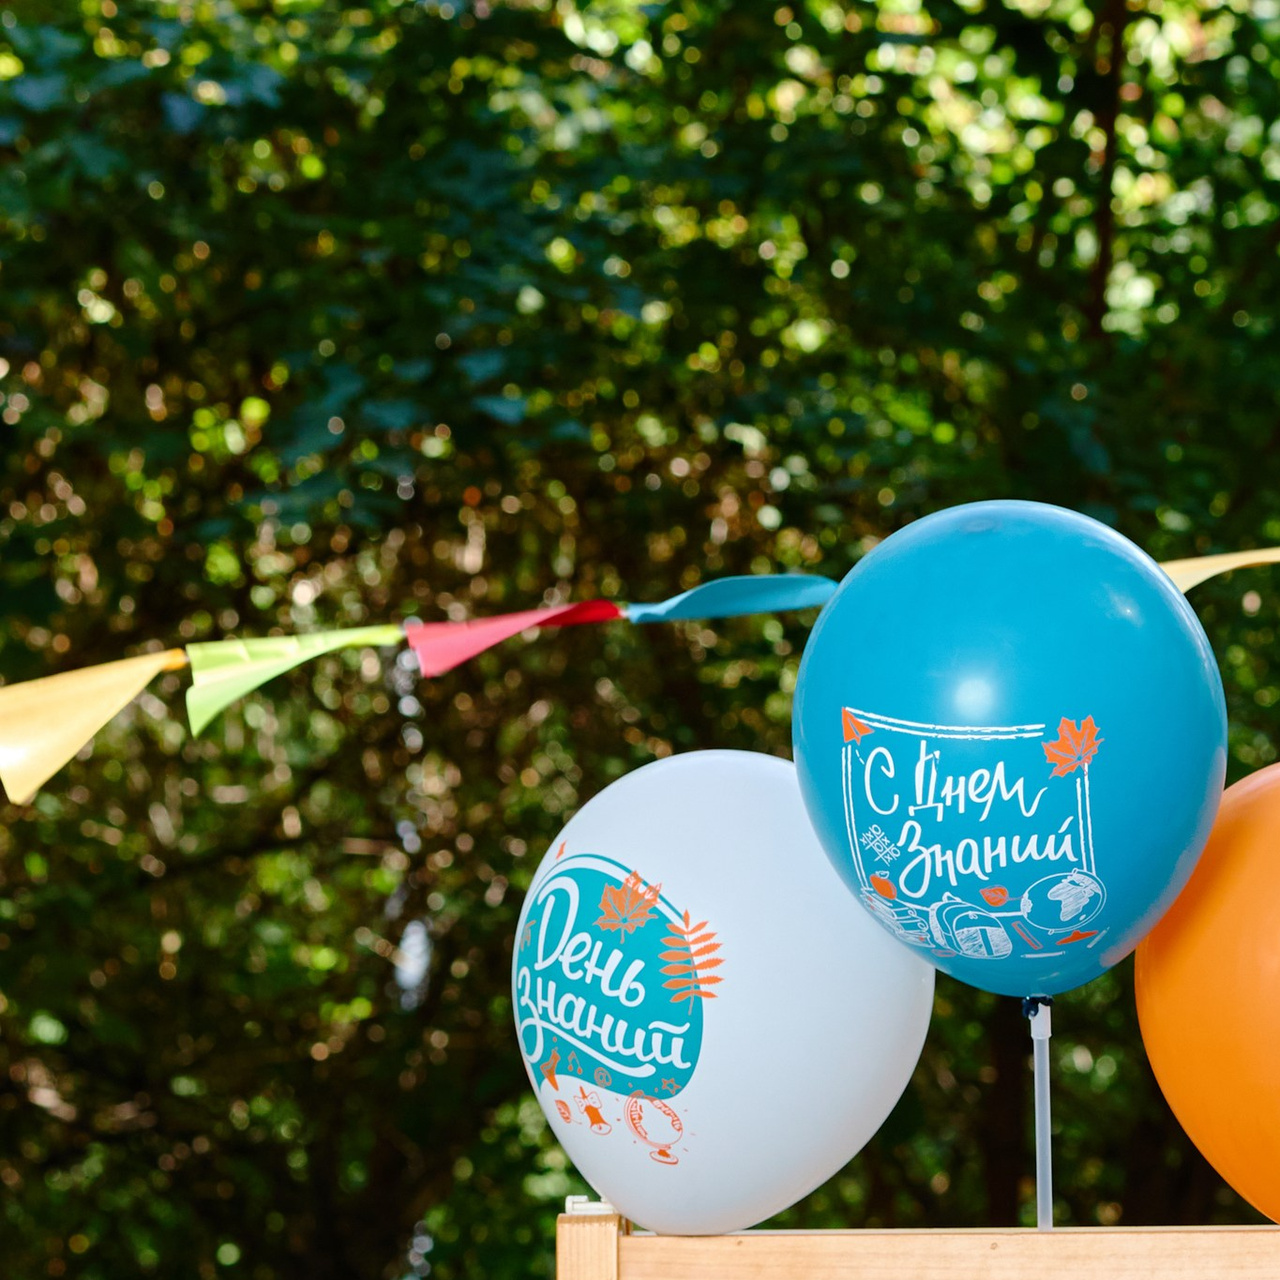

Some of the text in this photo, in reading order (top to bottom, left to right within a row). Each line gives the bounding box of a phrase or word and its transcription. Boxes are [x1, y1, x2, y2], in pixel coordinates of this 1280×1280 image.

[865, 739, 1048, 823] С Днем
[897, 815, 1079, 899] Знаний
[533, 875, 646, 1008] День
